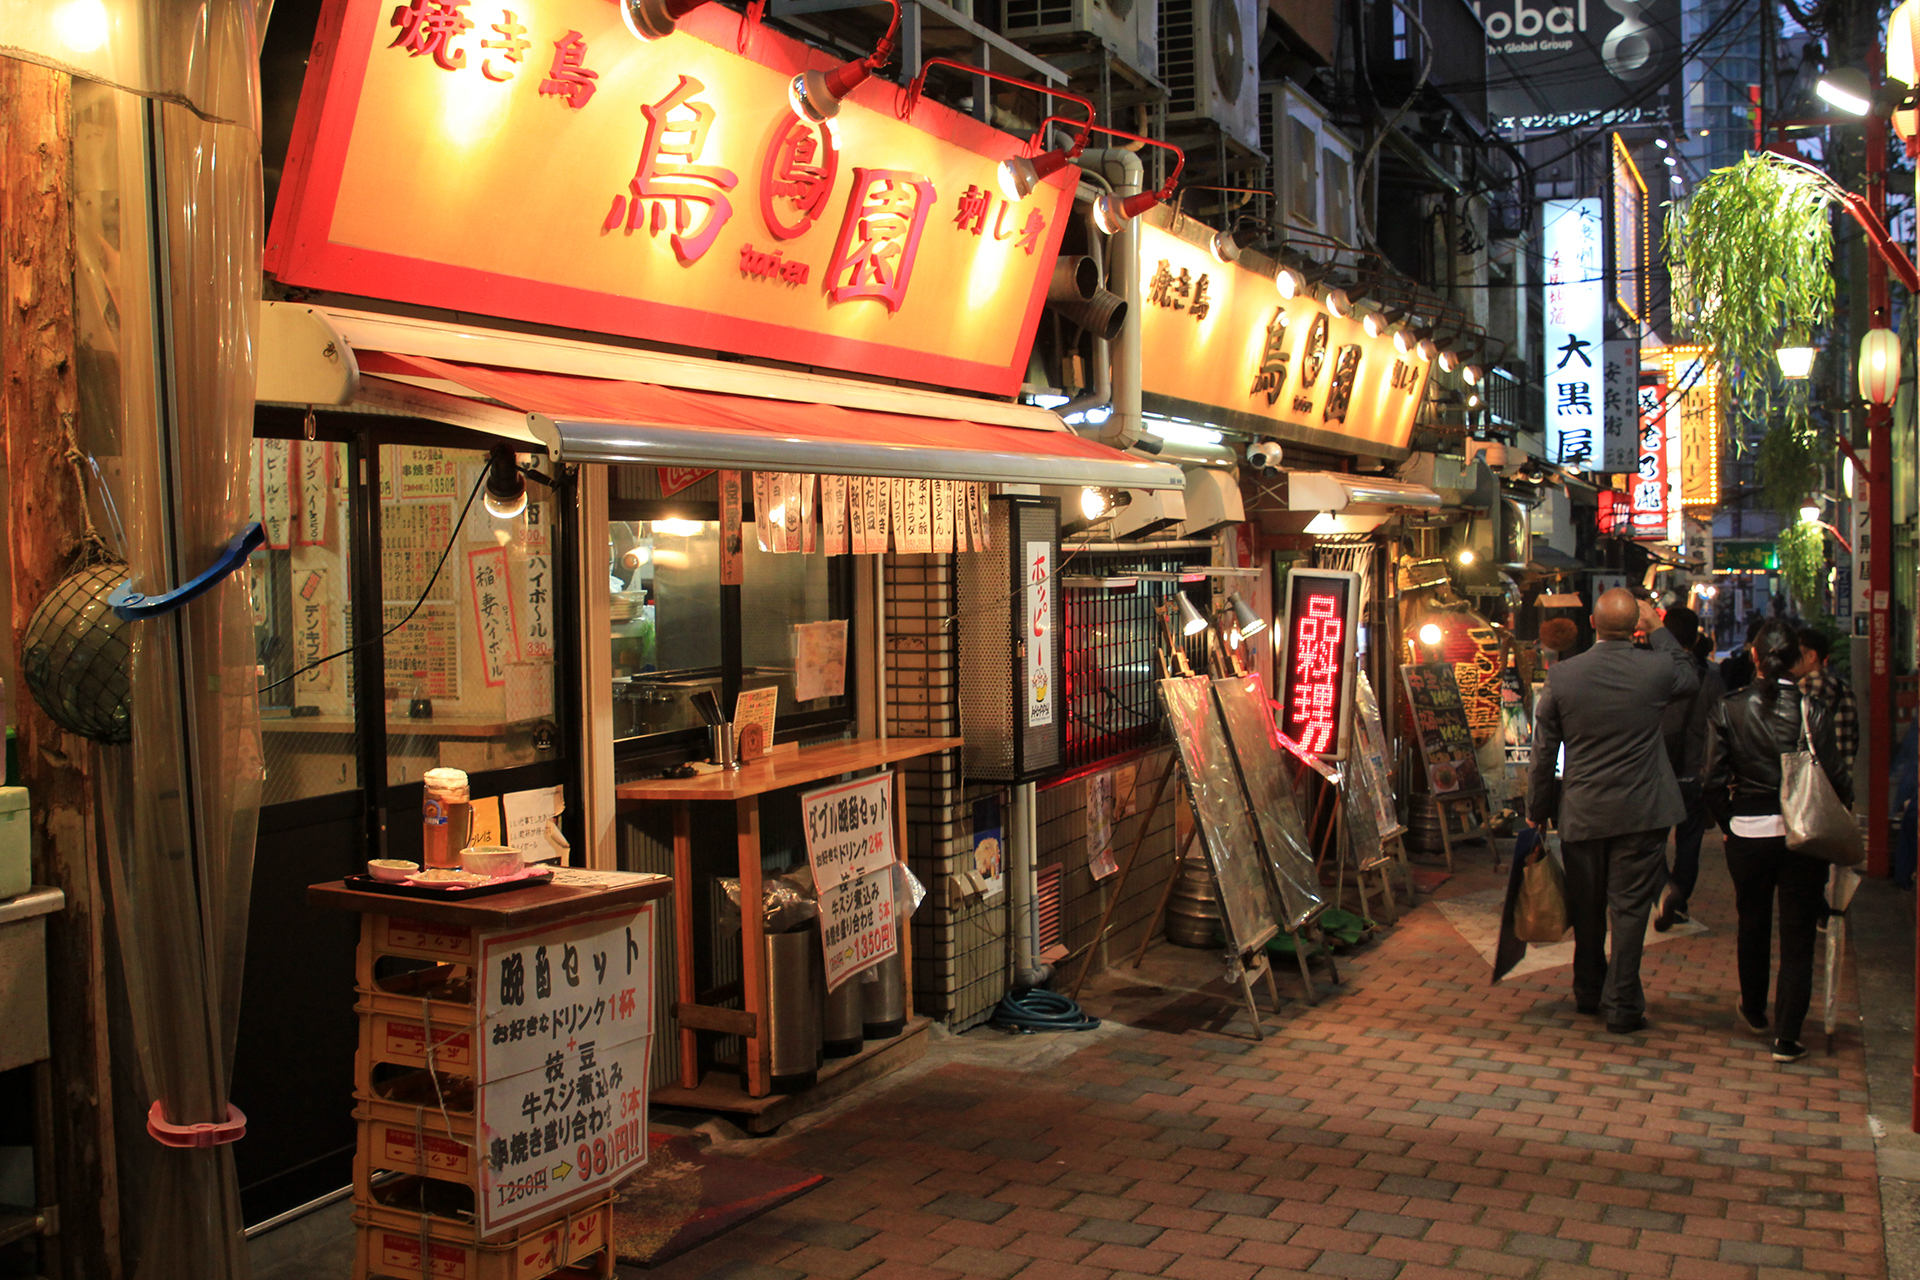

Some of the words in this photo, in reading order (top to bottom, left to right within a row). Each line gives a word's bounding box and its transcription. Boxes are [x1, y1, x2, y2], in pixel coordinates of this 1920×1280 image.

[386, 0, 600, 109] 焼き鳥
[1504, 41, 1538, 53] Global
[1540, 39, 1574, 52] Group
[602, 74, 738, 267] 鳥
[825, 166, 937, 314] 園
[952, 183, 1046, 256] 刺し身
[1146, 259, 1210, 321] 焼き鳥
[1250, 306, 1290, 405] 鳥
[1557, 334, 1592, 464] 大黒屋
[476, 566, 503, 678] 稲妻ハイボール
[1032, 550, 1048, 667] ホッピー
[305, 603, 320, 682] デンキブラン
[1031, 704, 1050, 718] HOPPY
[809, 788, 888, 844] ダブル晩酌セット
[816, 831, 884, 869] お好きなドリンク2杯
[825, 907, 874, 950] 串焼き盛り合わせ
[831, 882, 880, 920] 牛スジ煮込み
[878, 899, 891, 921] 5本
[501, 926, 639, 1007] 晩酌セット
[492, 988, 636, 1046] お好きなドリンク1杯
[521, 1061, 623, 1125] 牛スジ煮込み
[544, 1040, 597, 1084] 枝豆
[620, 1086, 641, 1119] 3本
[490, 1099, 613, 1173] 串焼き盛り合わせ
